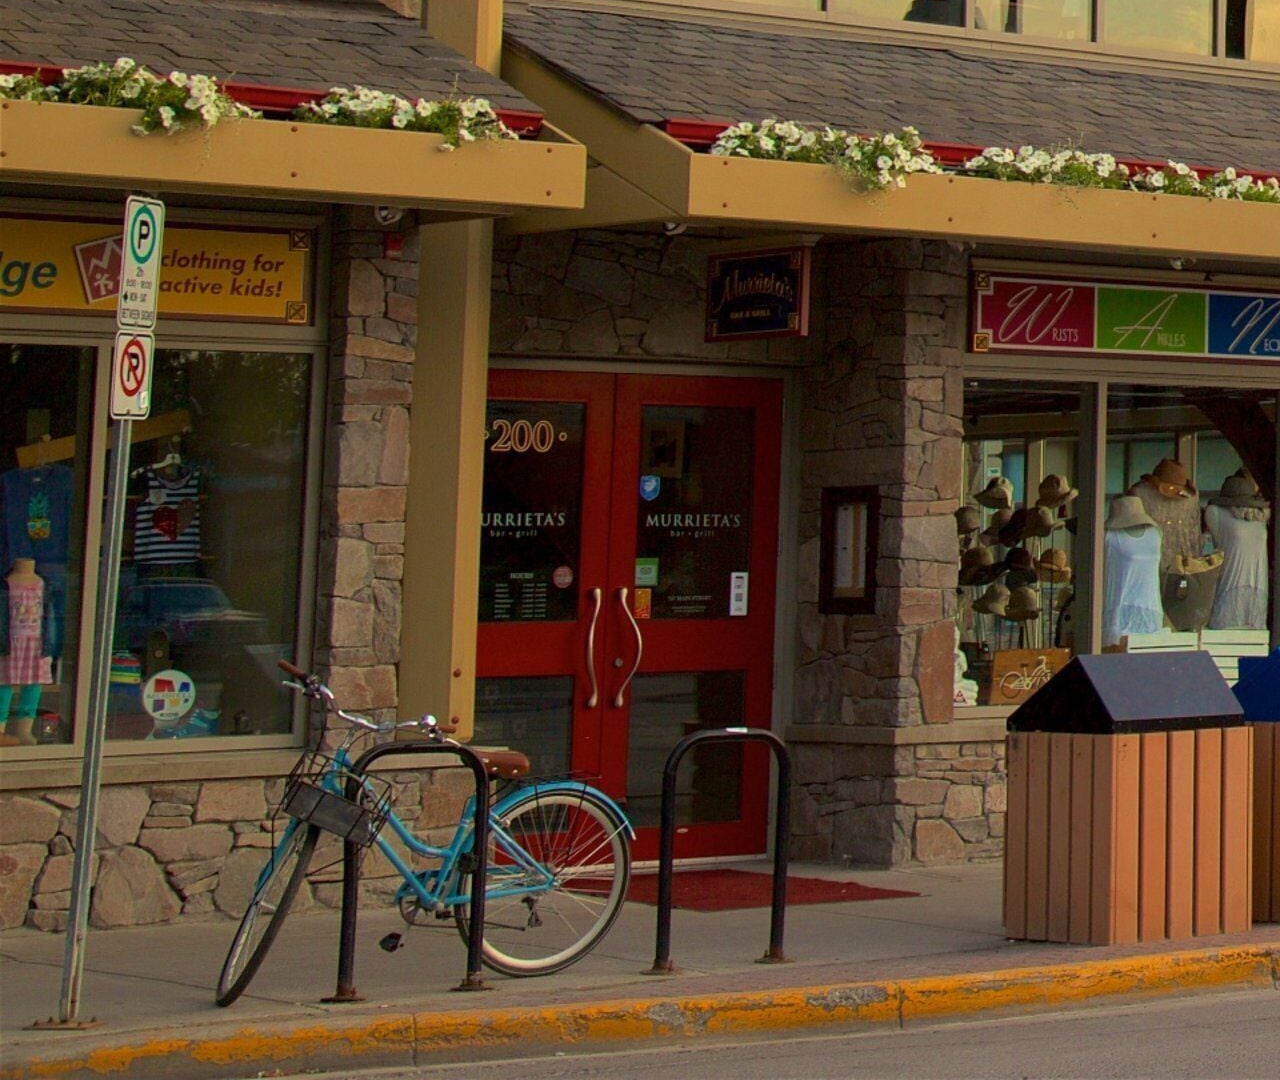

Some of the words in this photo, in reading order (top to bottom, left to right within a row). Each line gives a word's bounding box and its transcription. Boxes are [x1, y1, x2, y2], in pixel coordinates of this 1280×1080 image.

[0, 251, 58, 297] ge
[161, 250, 246, 275] clothing
[252, 252, 285, 273] for
[159, 278, 223, 295] active
[229, 277, 283, 298] kids!
[490, 419, 555, 453] 200
[480, 511, 567, 527] URRIETA'S
[645, 512, 742, 528] MURRIETA'S
